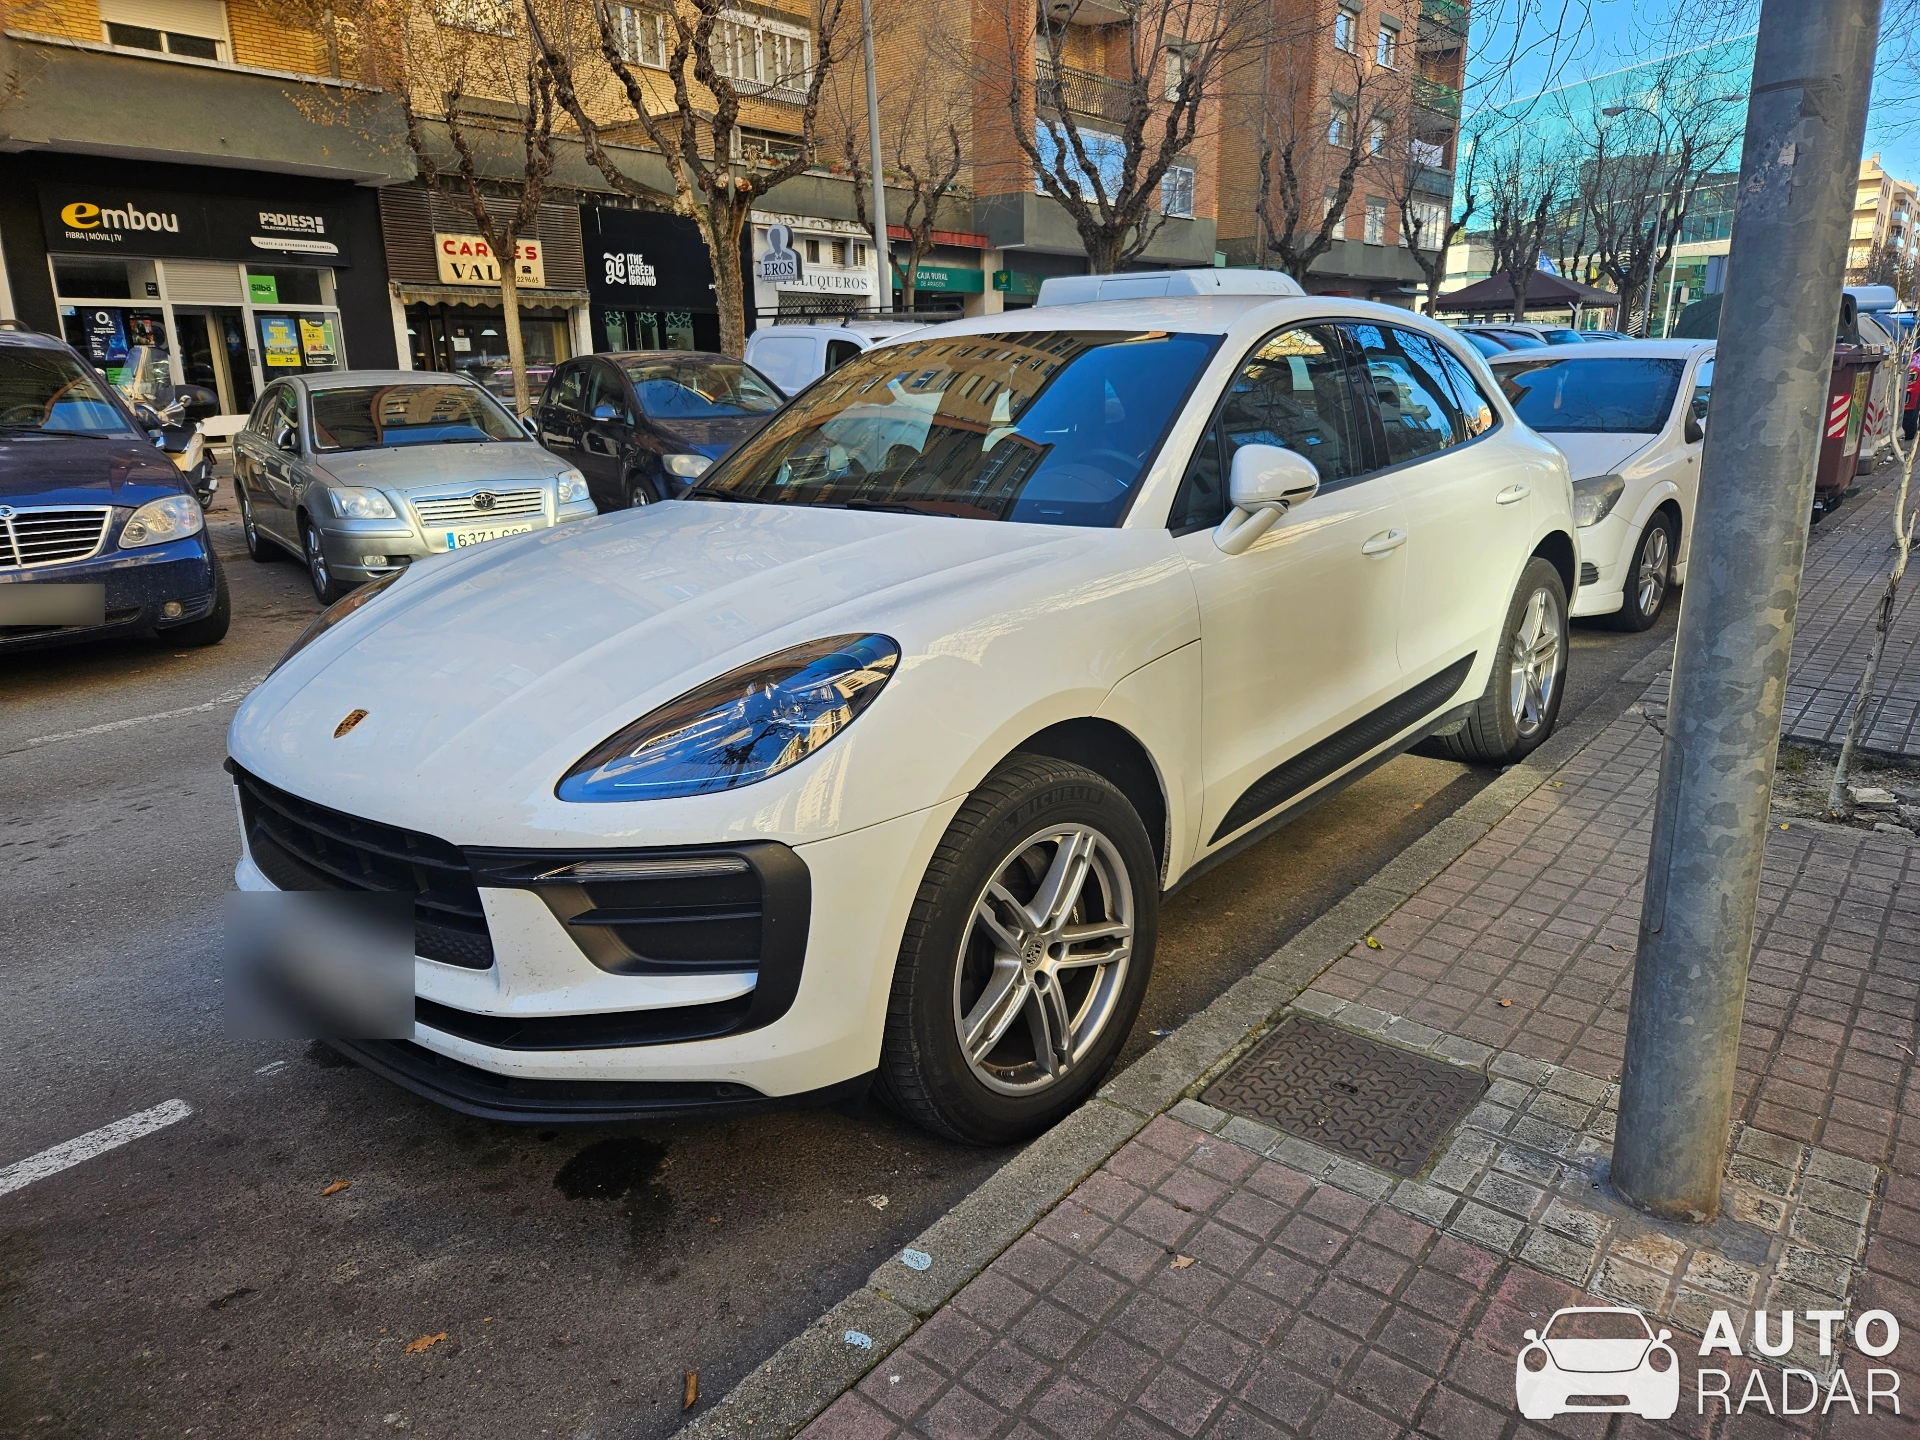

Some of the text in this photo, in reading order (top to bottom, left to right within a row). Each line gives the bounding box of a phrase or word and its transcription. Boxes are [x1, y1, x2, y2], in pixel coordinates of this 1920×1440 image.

[61, 202, 179, 232] embou
[65, 231, 85, 240] FIBRA
[89, 232, 111, 241] MÓVIL
[443, 240, 538, 260] CARES
[630, 254, 643, 265] THE
[630, 265, 655, 277] GREEN
[764, 262, 794, 276] EROS
[630, 275, 657, 287] BRAND
[916, 271, 931, 280] CAJA
